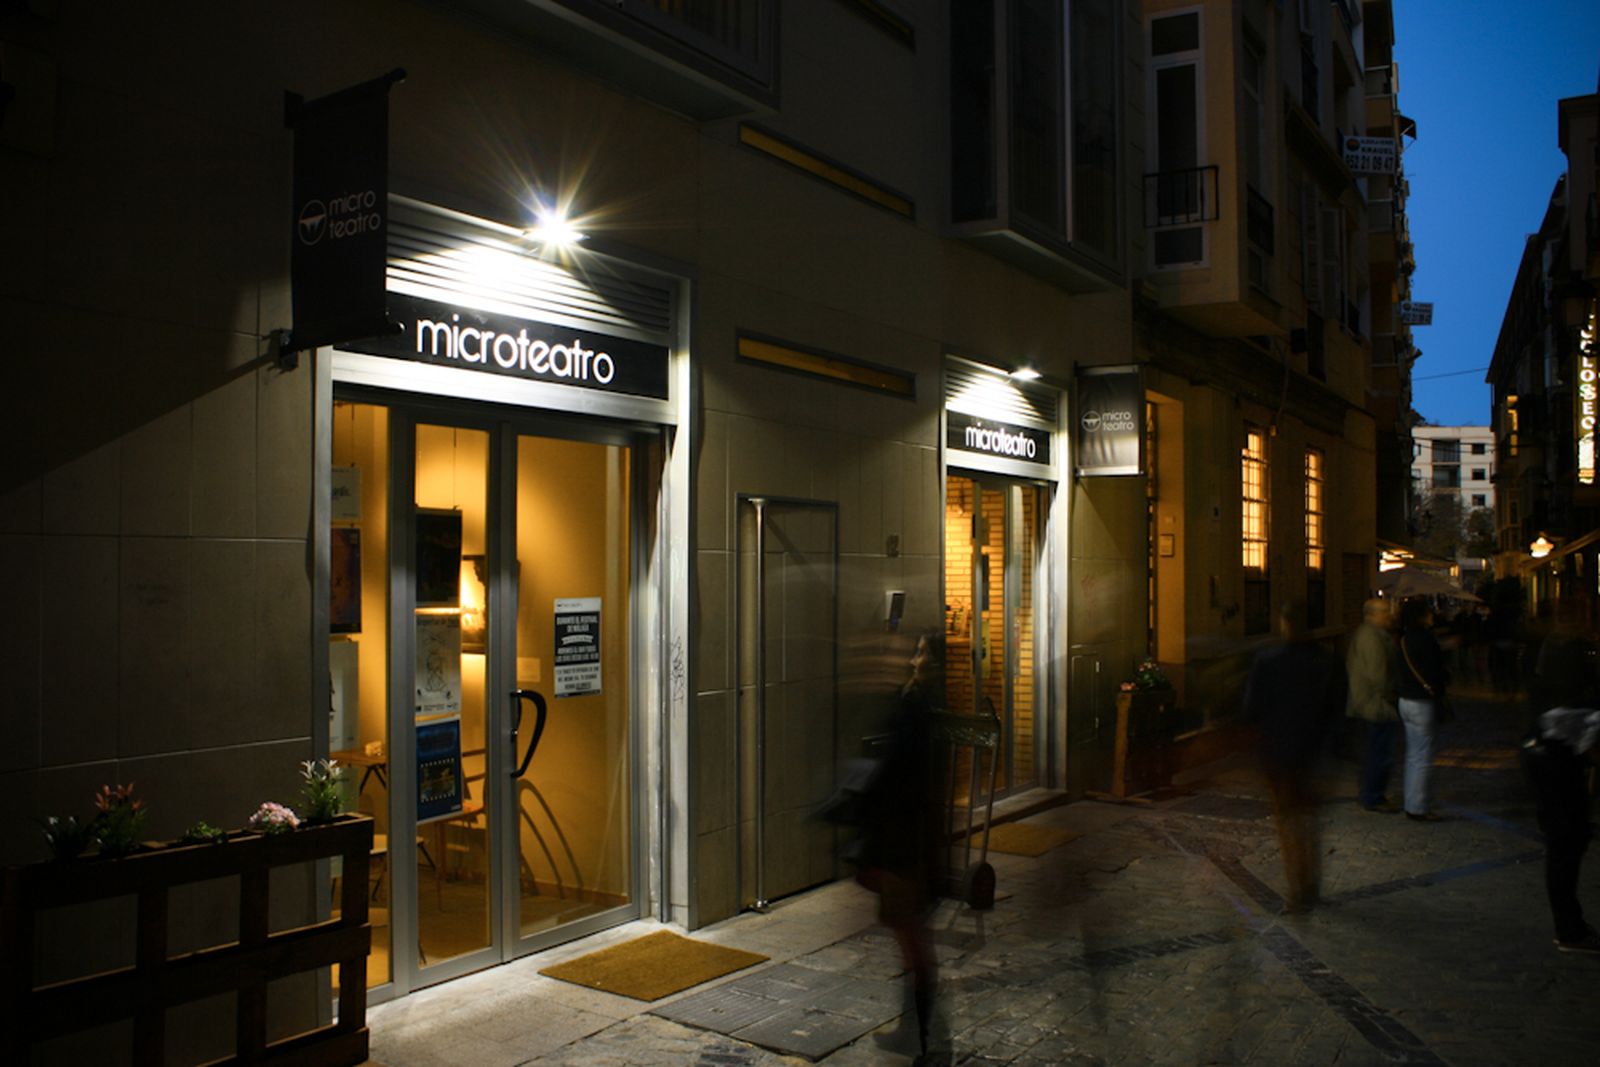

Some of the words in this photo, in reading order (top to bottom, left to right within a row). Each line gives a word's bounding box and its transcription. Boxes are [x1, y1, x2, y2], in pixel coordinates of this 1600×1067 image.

[329, 189, 376, 216] micro
[329, 212, 381, 239] teatro
[416, 313, 614, 384] microteatro
[1102, 410, 1131, 421] micro
[1102, 421, 1135, 431] teatro
[965, 422, 1036, 458] microteatro
